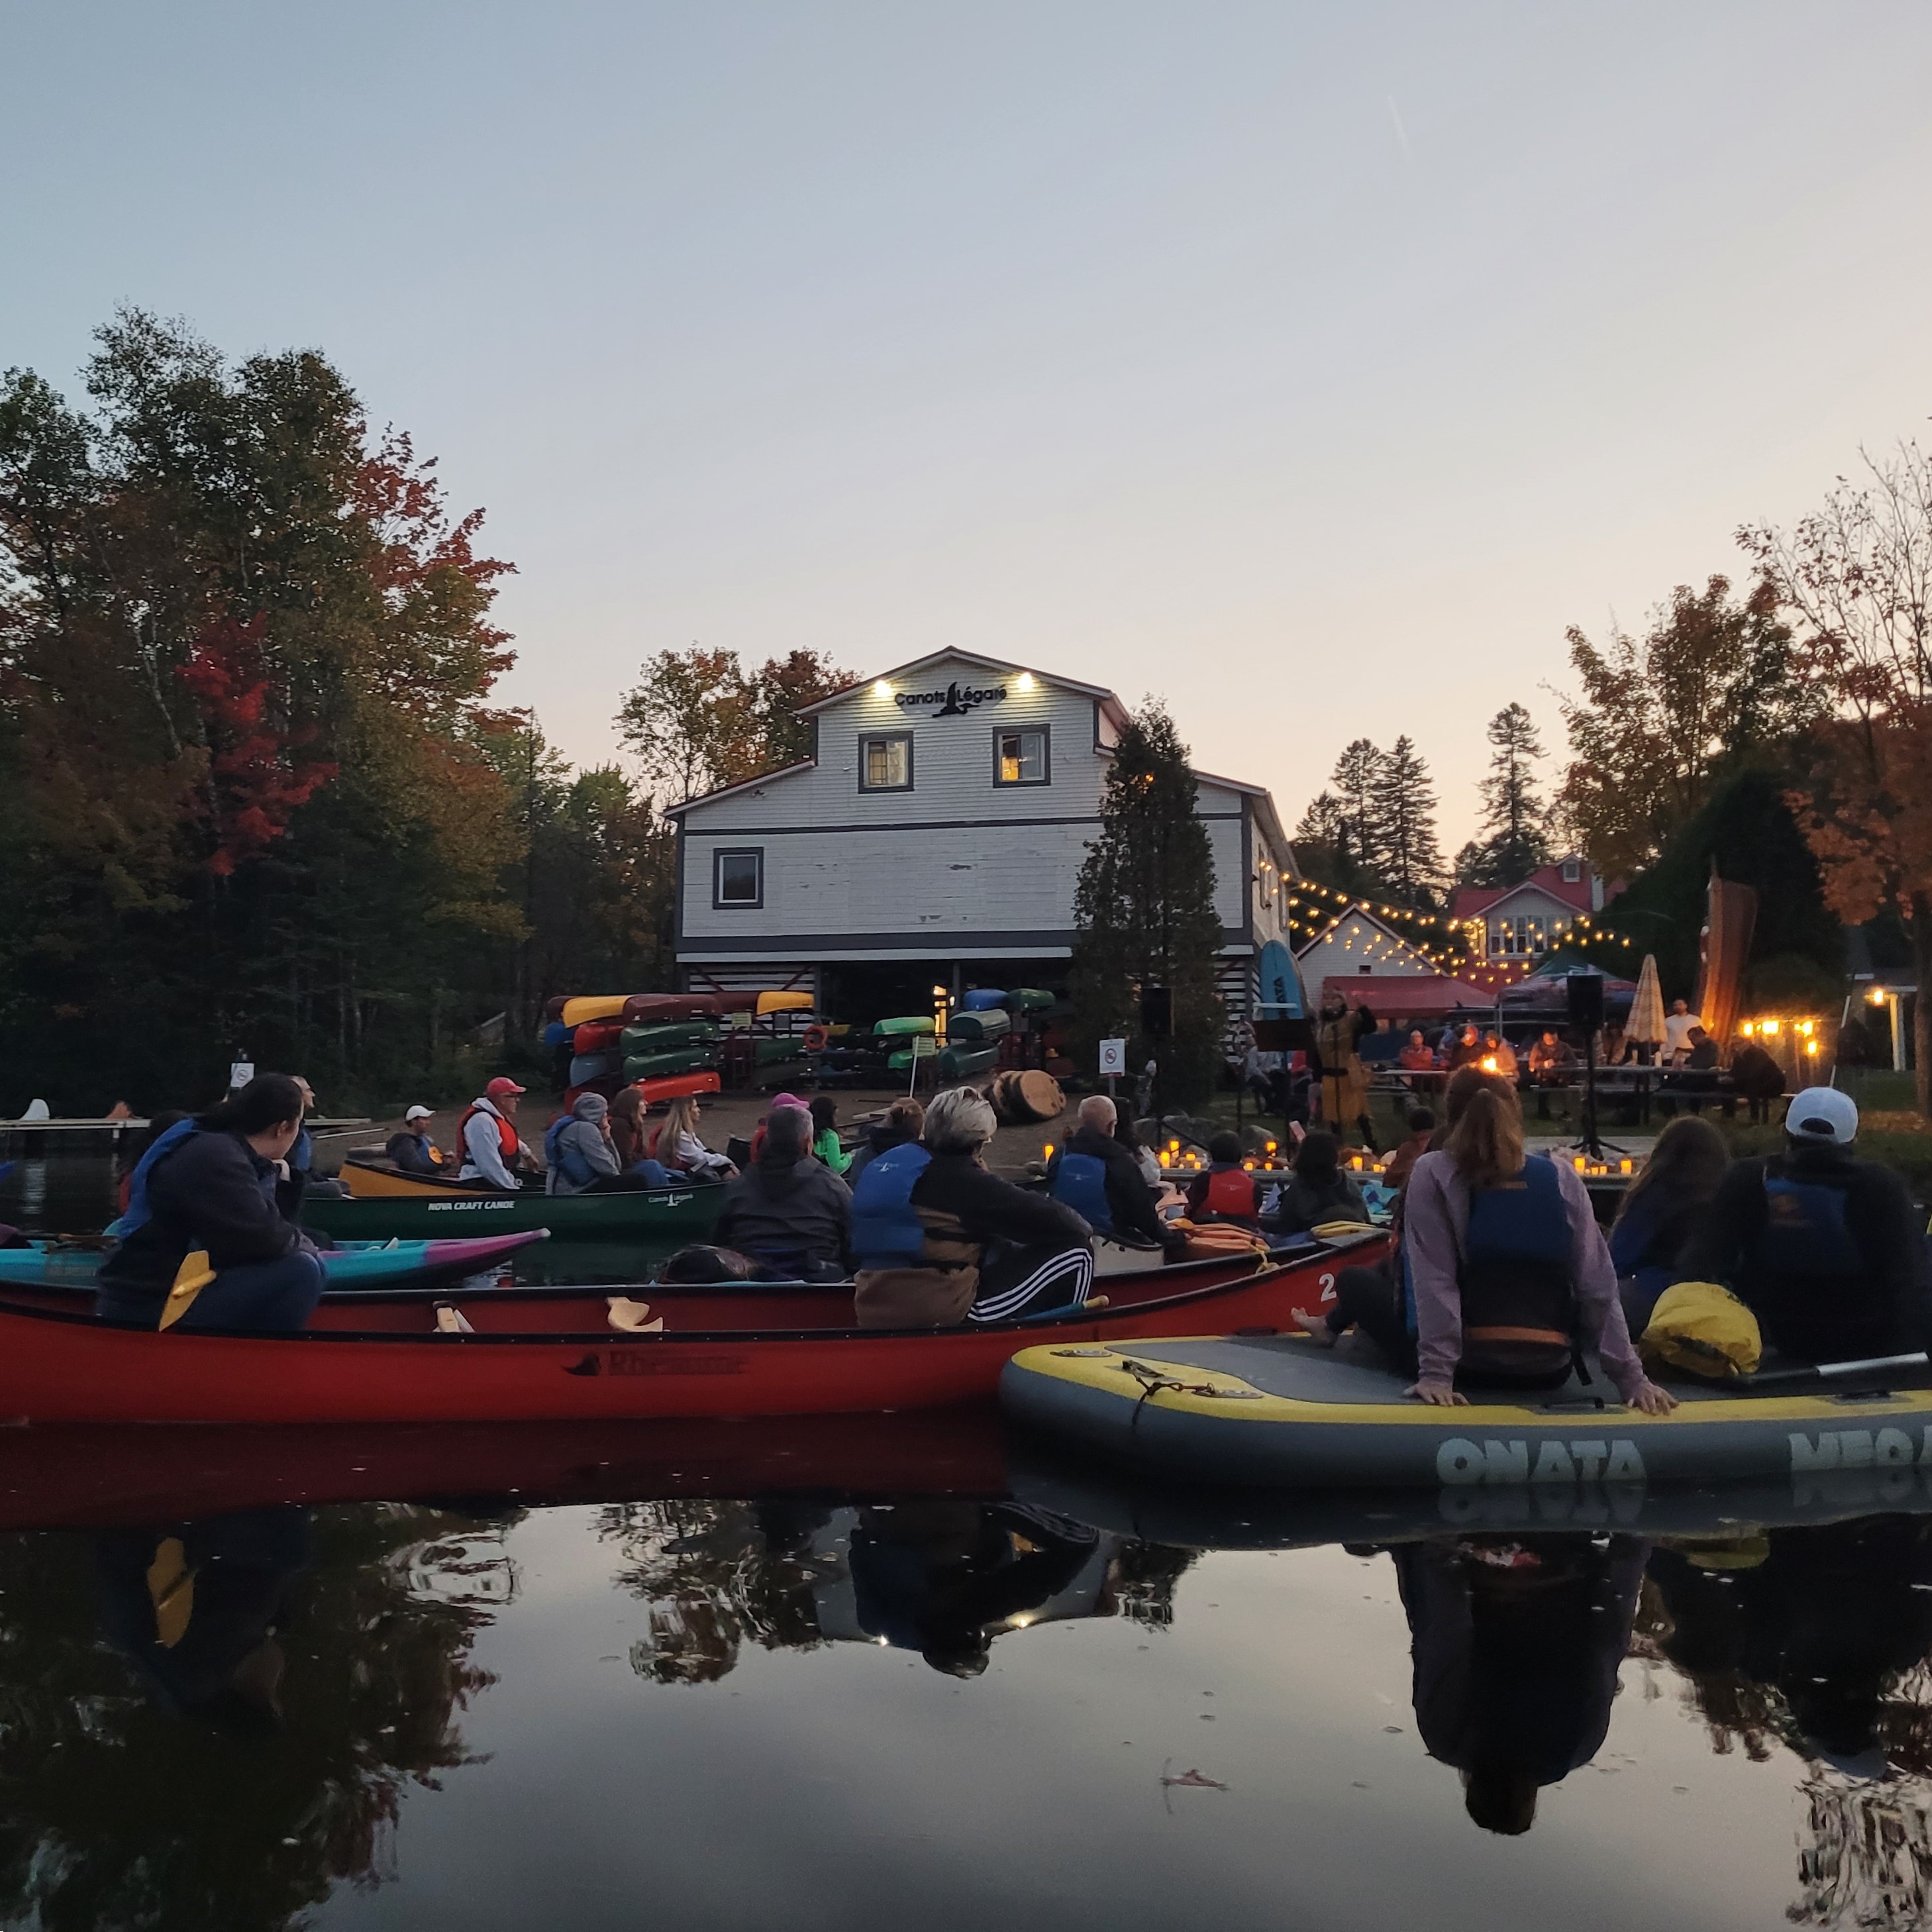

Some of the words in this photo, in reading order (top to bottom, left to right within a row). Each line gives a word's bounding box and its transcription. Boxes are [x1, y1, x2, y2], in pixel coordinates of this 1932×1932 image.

[895, 691, 945, 705] Canots
[958, 684, 1007, 703] Légaré
[485, 1201, 515, 1209] CANOE
[1319, 1272, 1337, 1303] 2
[1436, 1438, 1647, 1484] ONATA
[1788, 1425, 1932, 1471] MEG
